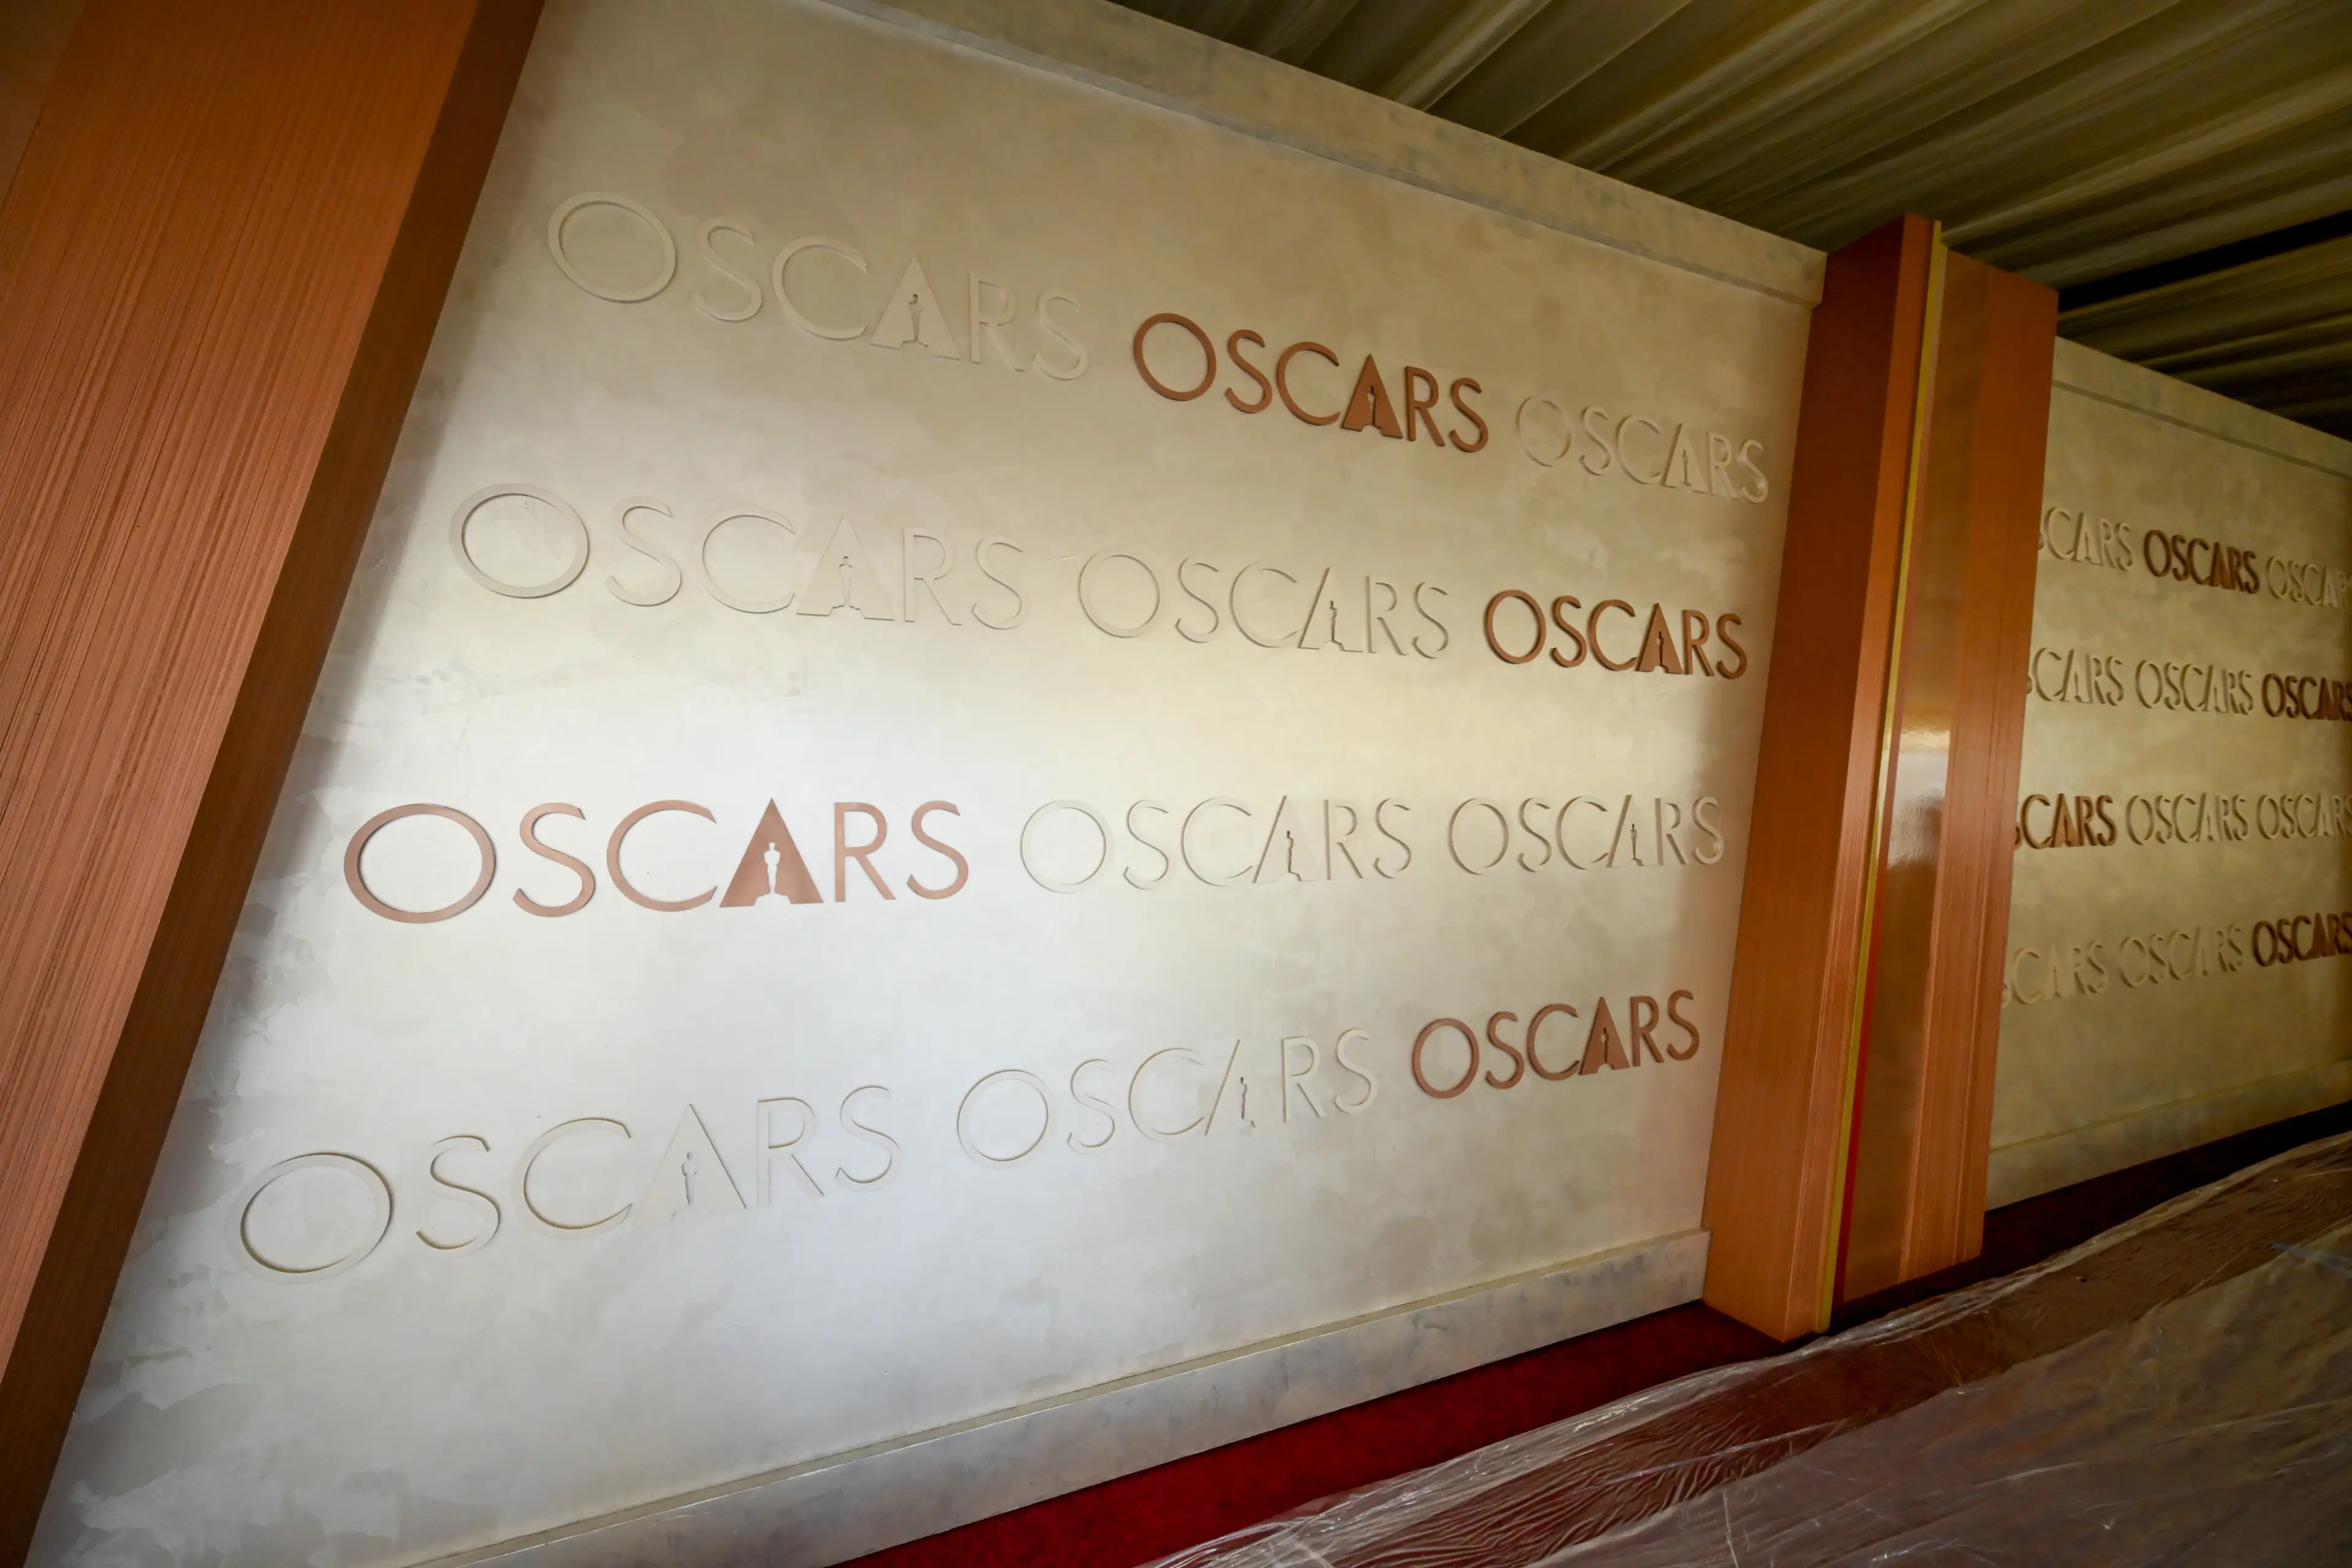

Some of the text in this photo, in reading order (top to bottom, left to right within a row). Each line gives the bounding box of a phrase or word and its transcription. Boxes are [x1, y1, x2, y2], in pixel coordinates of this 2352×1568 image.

[546, 192, 1770, 503] OSCARS OSCARS OSCARS
[448, 483, 1747, 679] OSCARS OSCARS OSCARS
[2038, 507, 2135, 572] CARS
[2143, 529, 2261, 594] OSCARS
[2026, 647, 2125, 706] CARS
[2135, 659, 2254, 715] OSCARS
[343, 794, 1724, 924] OSCARS OSCARS OSCARS
[2014, 793, 2117, 850] CARS
[2125, 793, 2248, 845] OSCARS
[2001, 938, 2109, 1009] CARS
[2117, 923, 2244, 989] OSCARS
[228, 990, 1701, 1284] OSCARS OSCARS OSCARS
